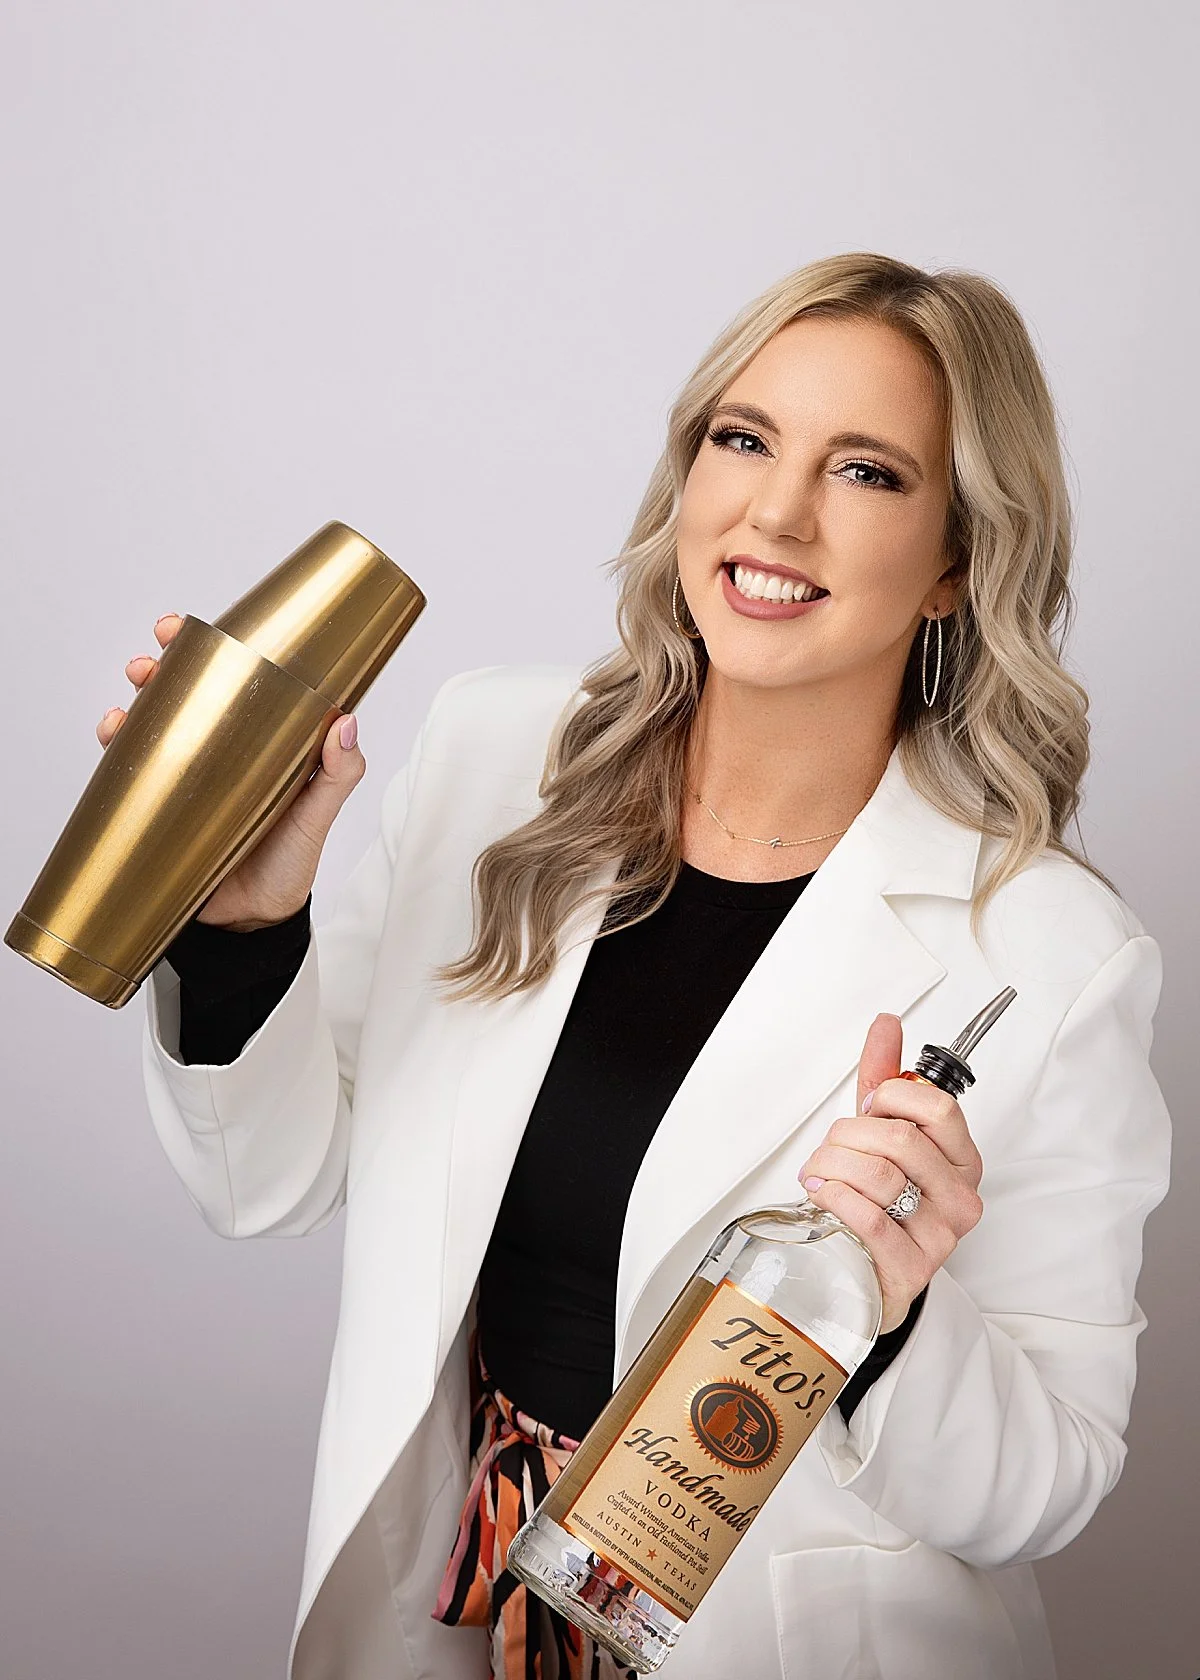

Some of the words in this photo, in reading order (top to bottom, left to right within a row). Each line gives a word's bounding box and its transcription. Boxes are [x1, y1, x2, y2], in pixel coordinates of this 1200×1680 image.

[711, 1317, 826, 1411] Tito's
[623, 1428, 760, 1533] Handmade
[645, 1479, 711, 1542] VODKA
[571, 1512, 591, 1530] DISTILLED
[610, 1543, 619, 1551] BY
[616, 1547, 630, 1561] FIFTH
[597, 1511, 642, 1548] AUSTIN
[663, 1561, 697, 1591] TEXAS
[607, 1494, 632, 1516] Crafted
[629, 1511, 638, 1522] in
[637, 1519, 647, 1529] an
[647, 1526, 665, 1539] Old
[659, 1535, 691, 1561] Fashioned
[686, 1556, 698, 1569] Pot
[617, 1489, 643, 1509] Award
[640, 1504, 669, 1536] Winning
[667, 1528, 696, 1553] American
[695, 1547, 710, 1563] Vodka
